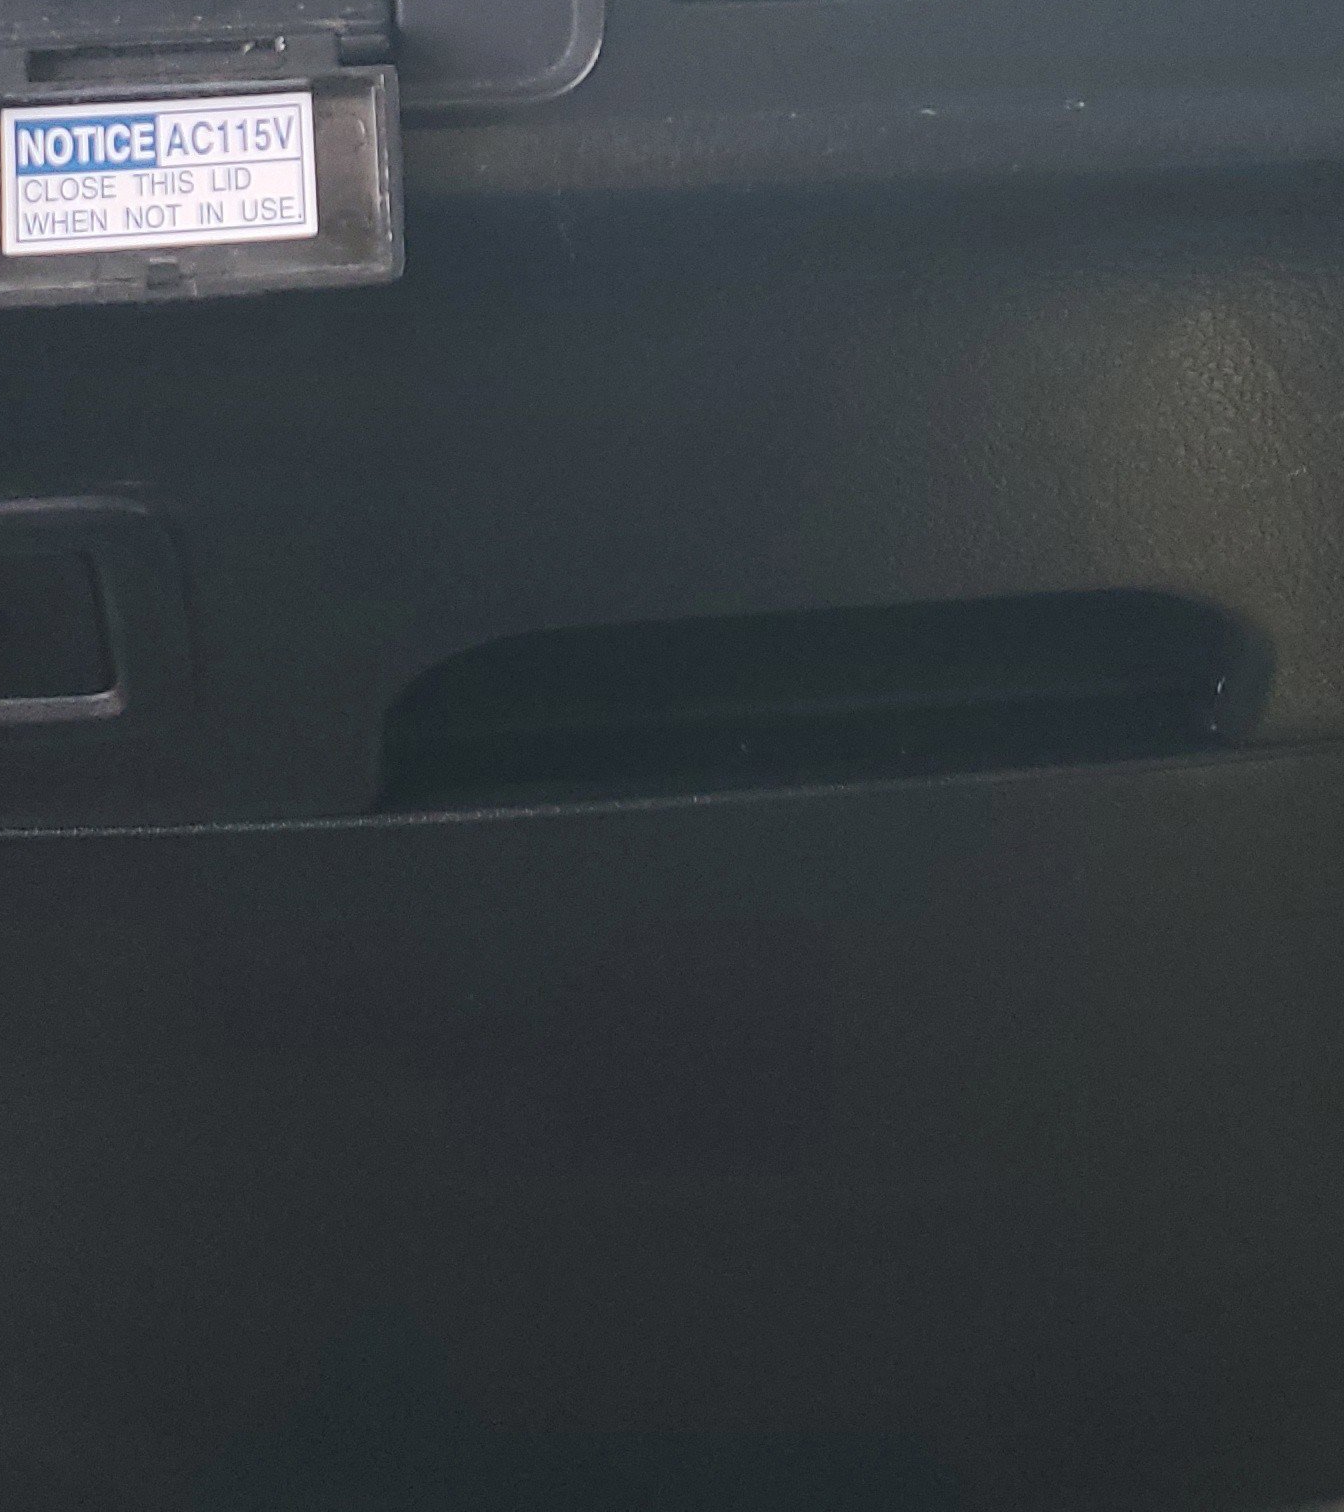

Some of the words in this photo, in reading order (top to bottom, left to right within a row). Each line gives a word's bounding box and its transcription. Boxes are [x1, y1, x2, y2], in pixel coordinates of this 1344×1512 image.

[17, 123, 155, 167] NOTICE
[166, 116, 294, 157] AC115V
[24, 175, 117, 203] CLOSE
[133, 170, 195, 197] THIS
[211, 167, 252, 193] LID
[23, 210, 108, 236] WHEN
[125, 204, 181, 230] NOT
[200, 201, 225, 225] IN
[241, 196, 303, 222] USE.
